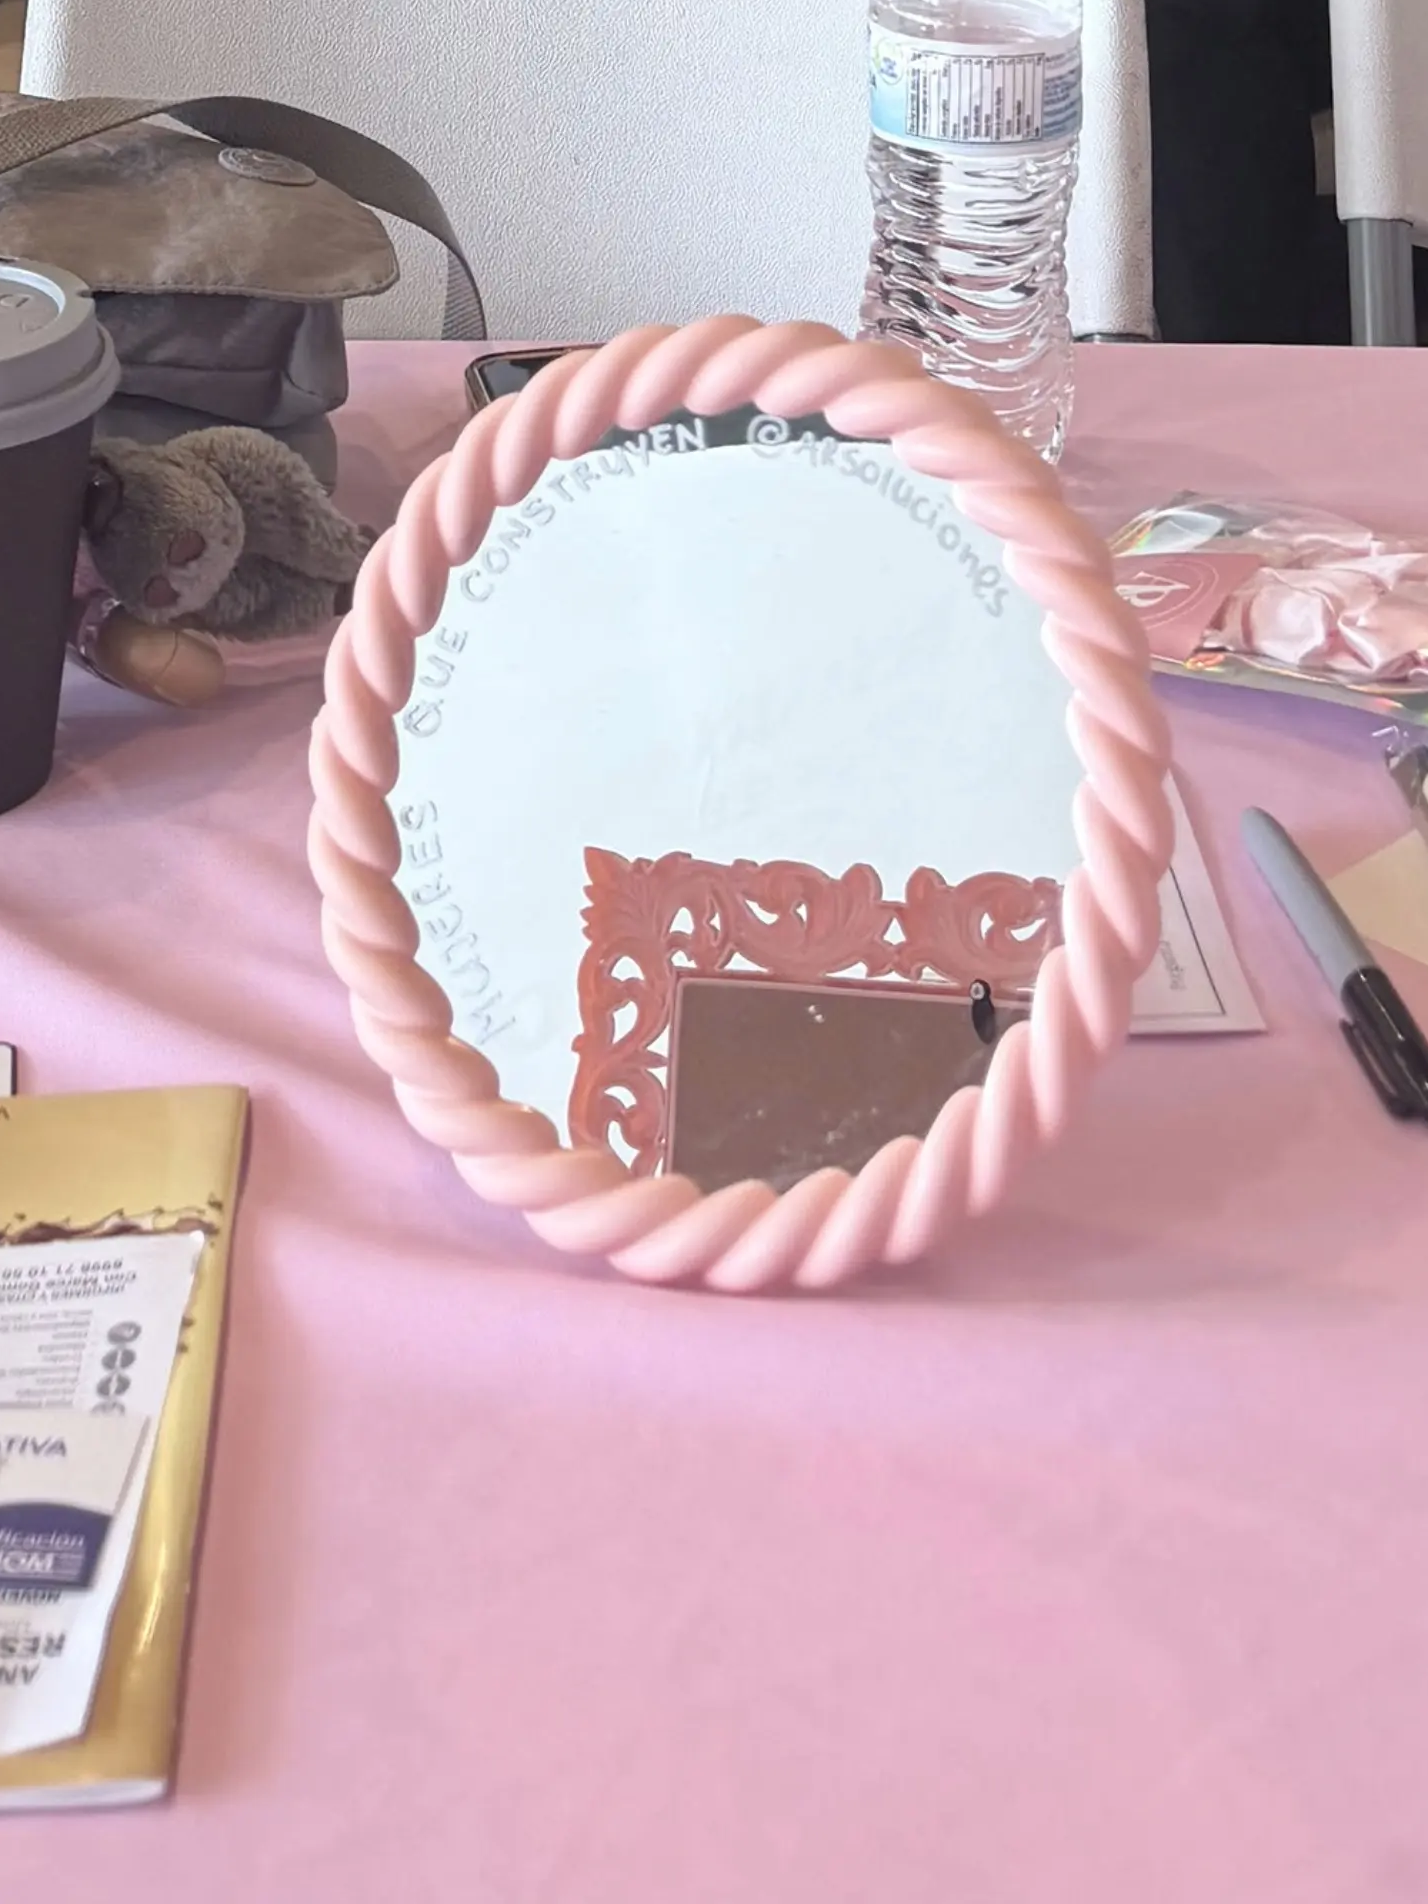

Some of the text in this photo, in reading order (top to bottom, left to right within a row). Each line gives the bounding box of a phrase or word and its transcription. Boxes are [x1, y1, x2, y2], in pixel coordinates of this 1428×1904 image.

[461, 415, 708, 604] CONSTRUYEN
[403, 624, 470, 740] QUE
[399, 798, 519, 1045] MUJERES
